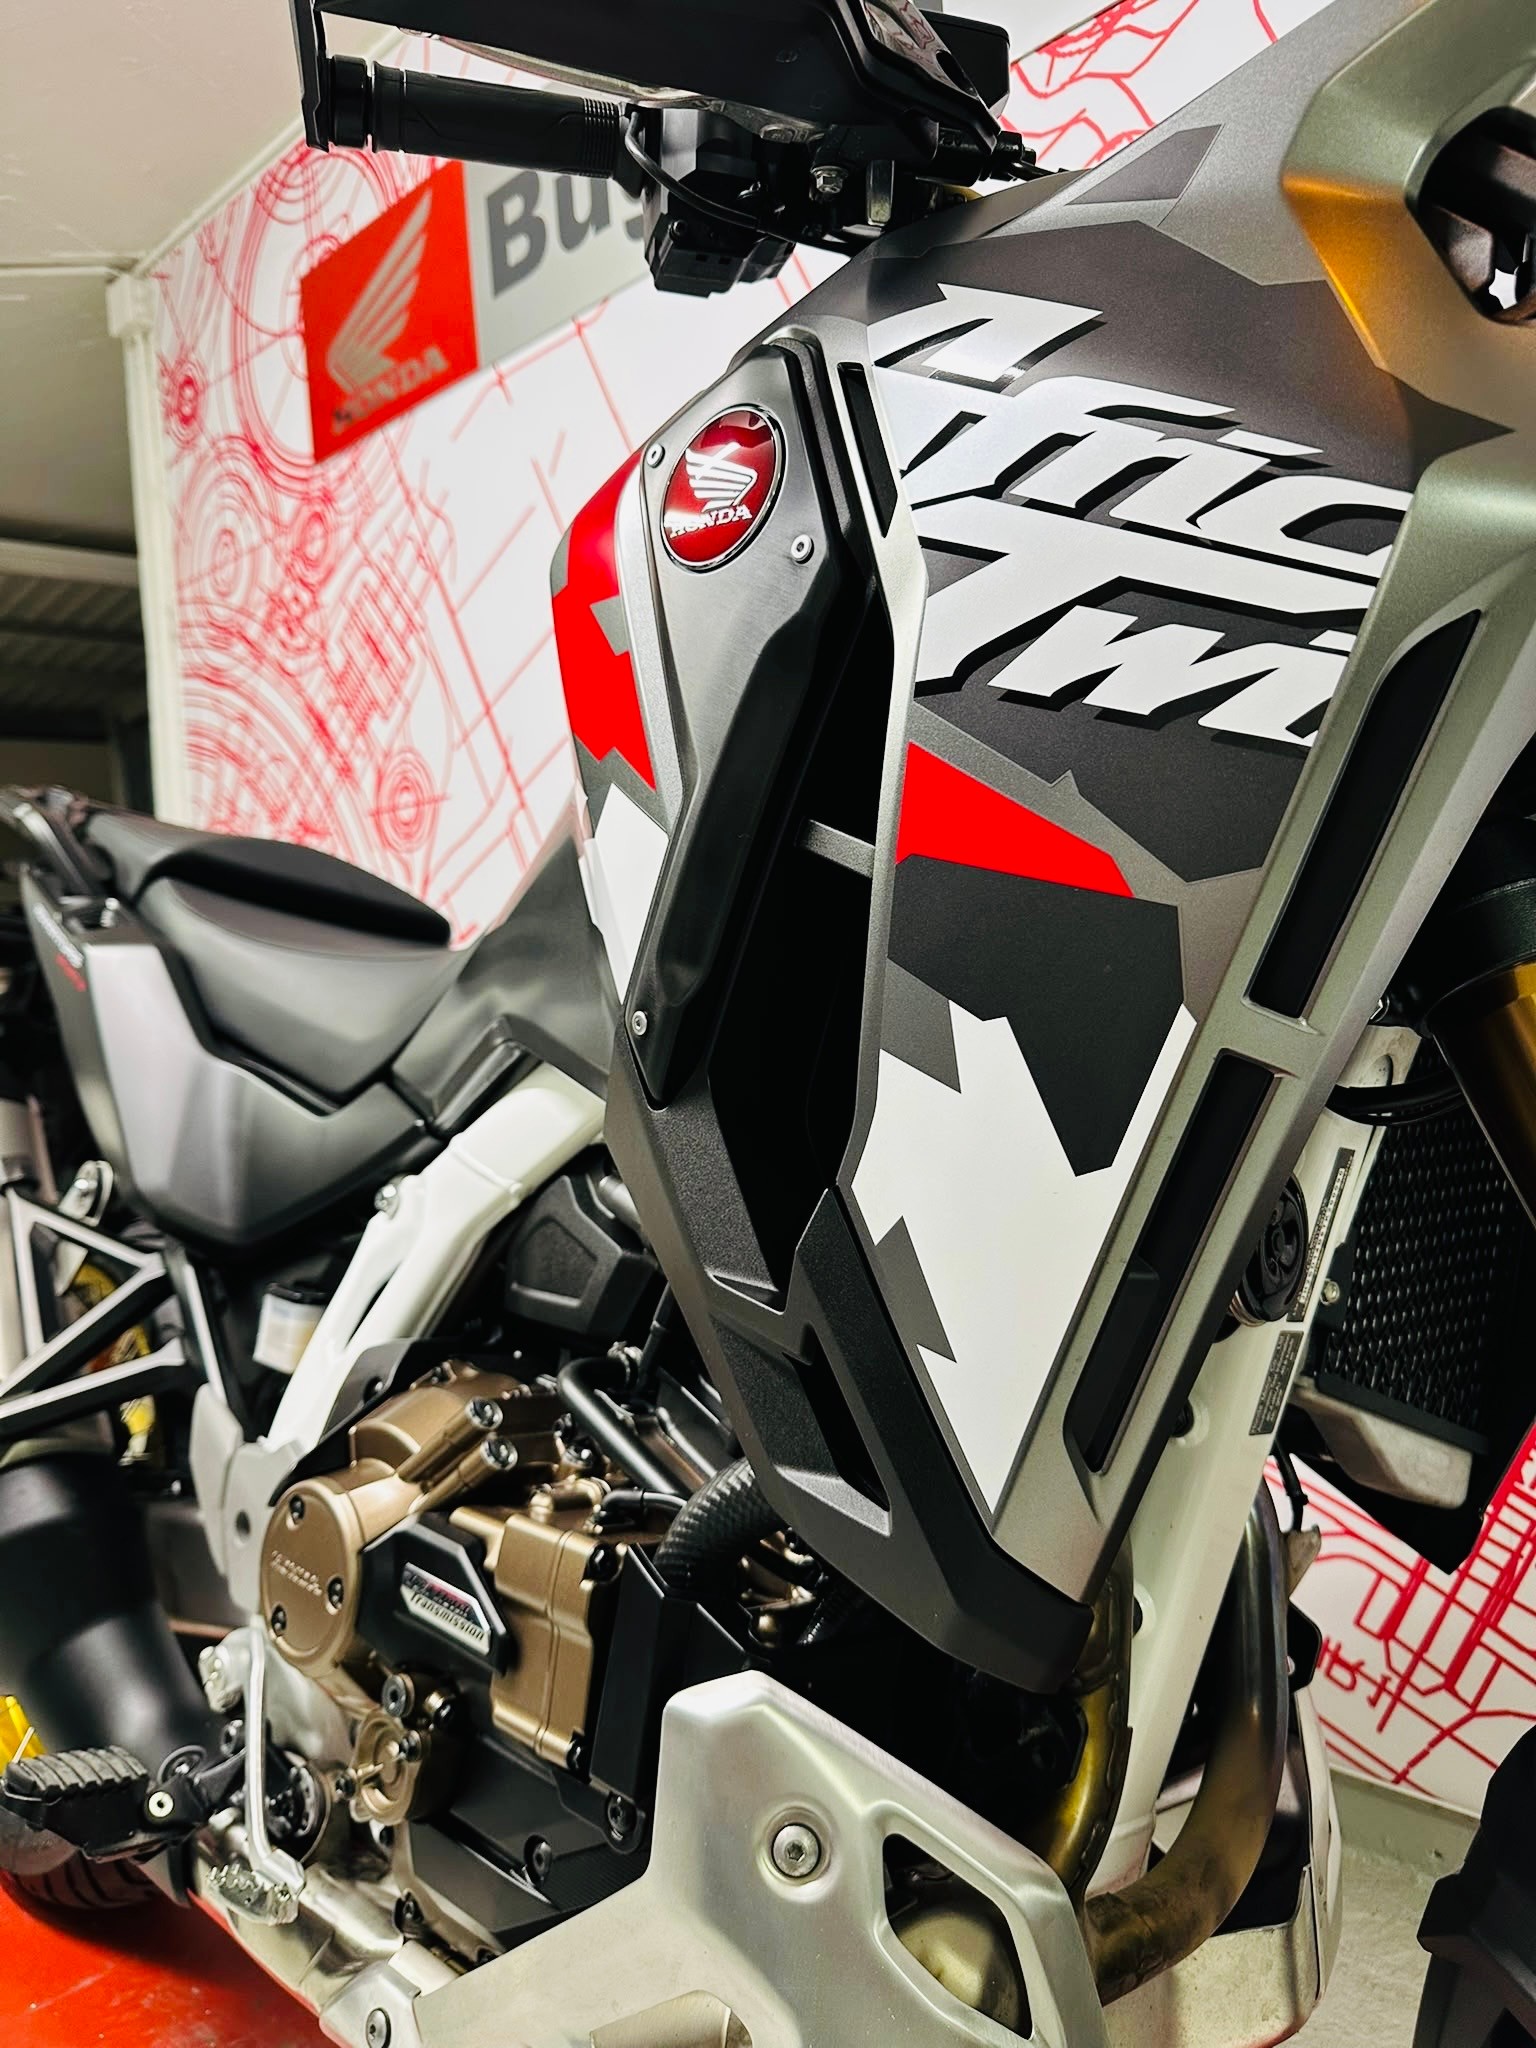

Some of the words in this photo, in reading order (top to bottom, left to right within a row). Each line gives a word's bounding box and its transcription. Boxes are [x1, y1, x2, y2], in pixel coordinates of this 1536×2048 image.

[486, 169, 644, 298] Bu
[331, 345, 449, 436] HONDA
[669, 503, 753, 539] HONDA
[410, 1590, 485, 1641] Transmission
